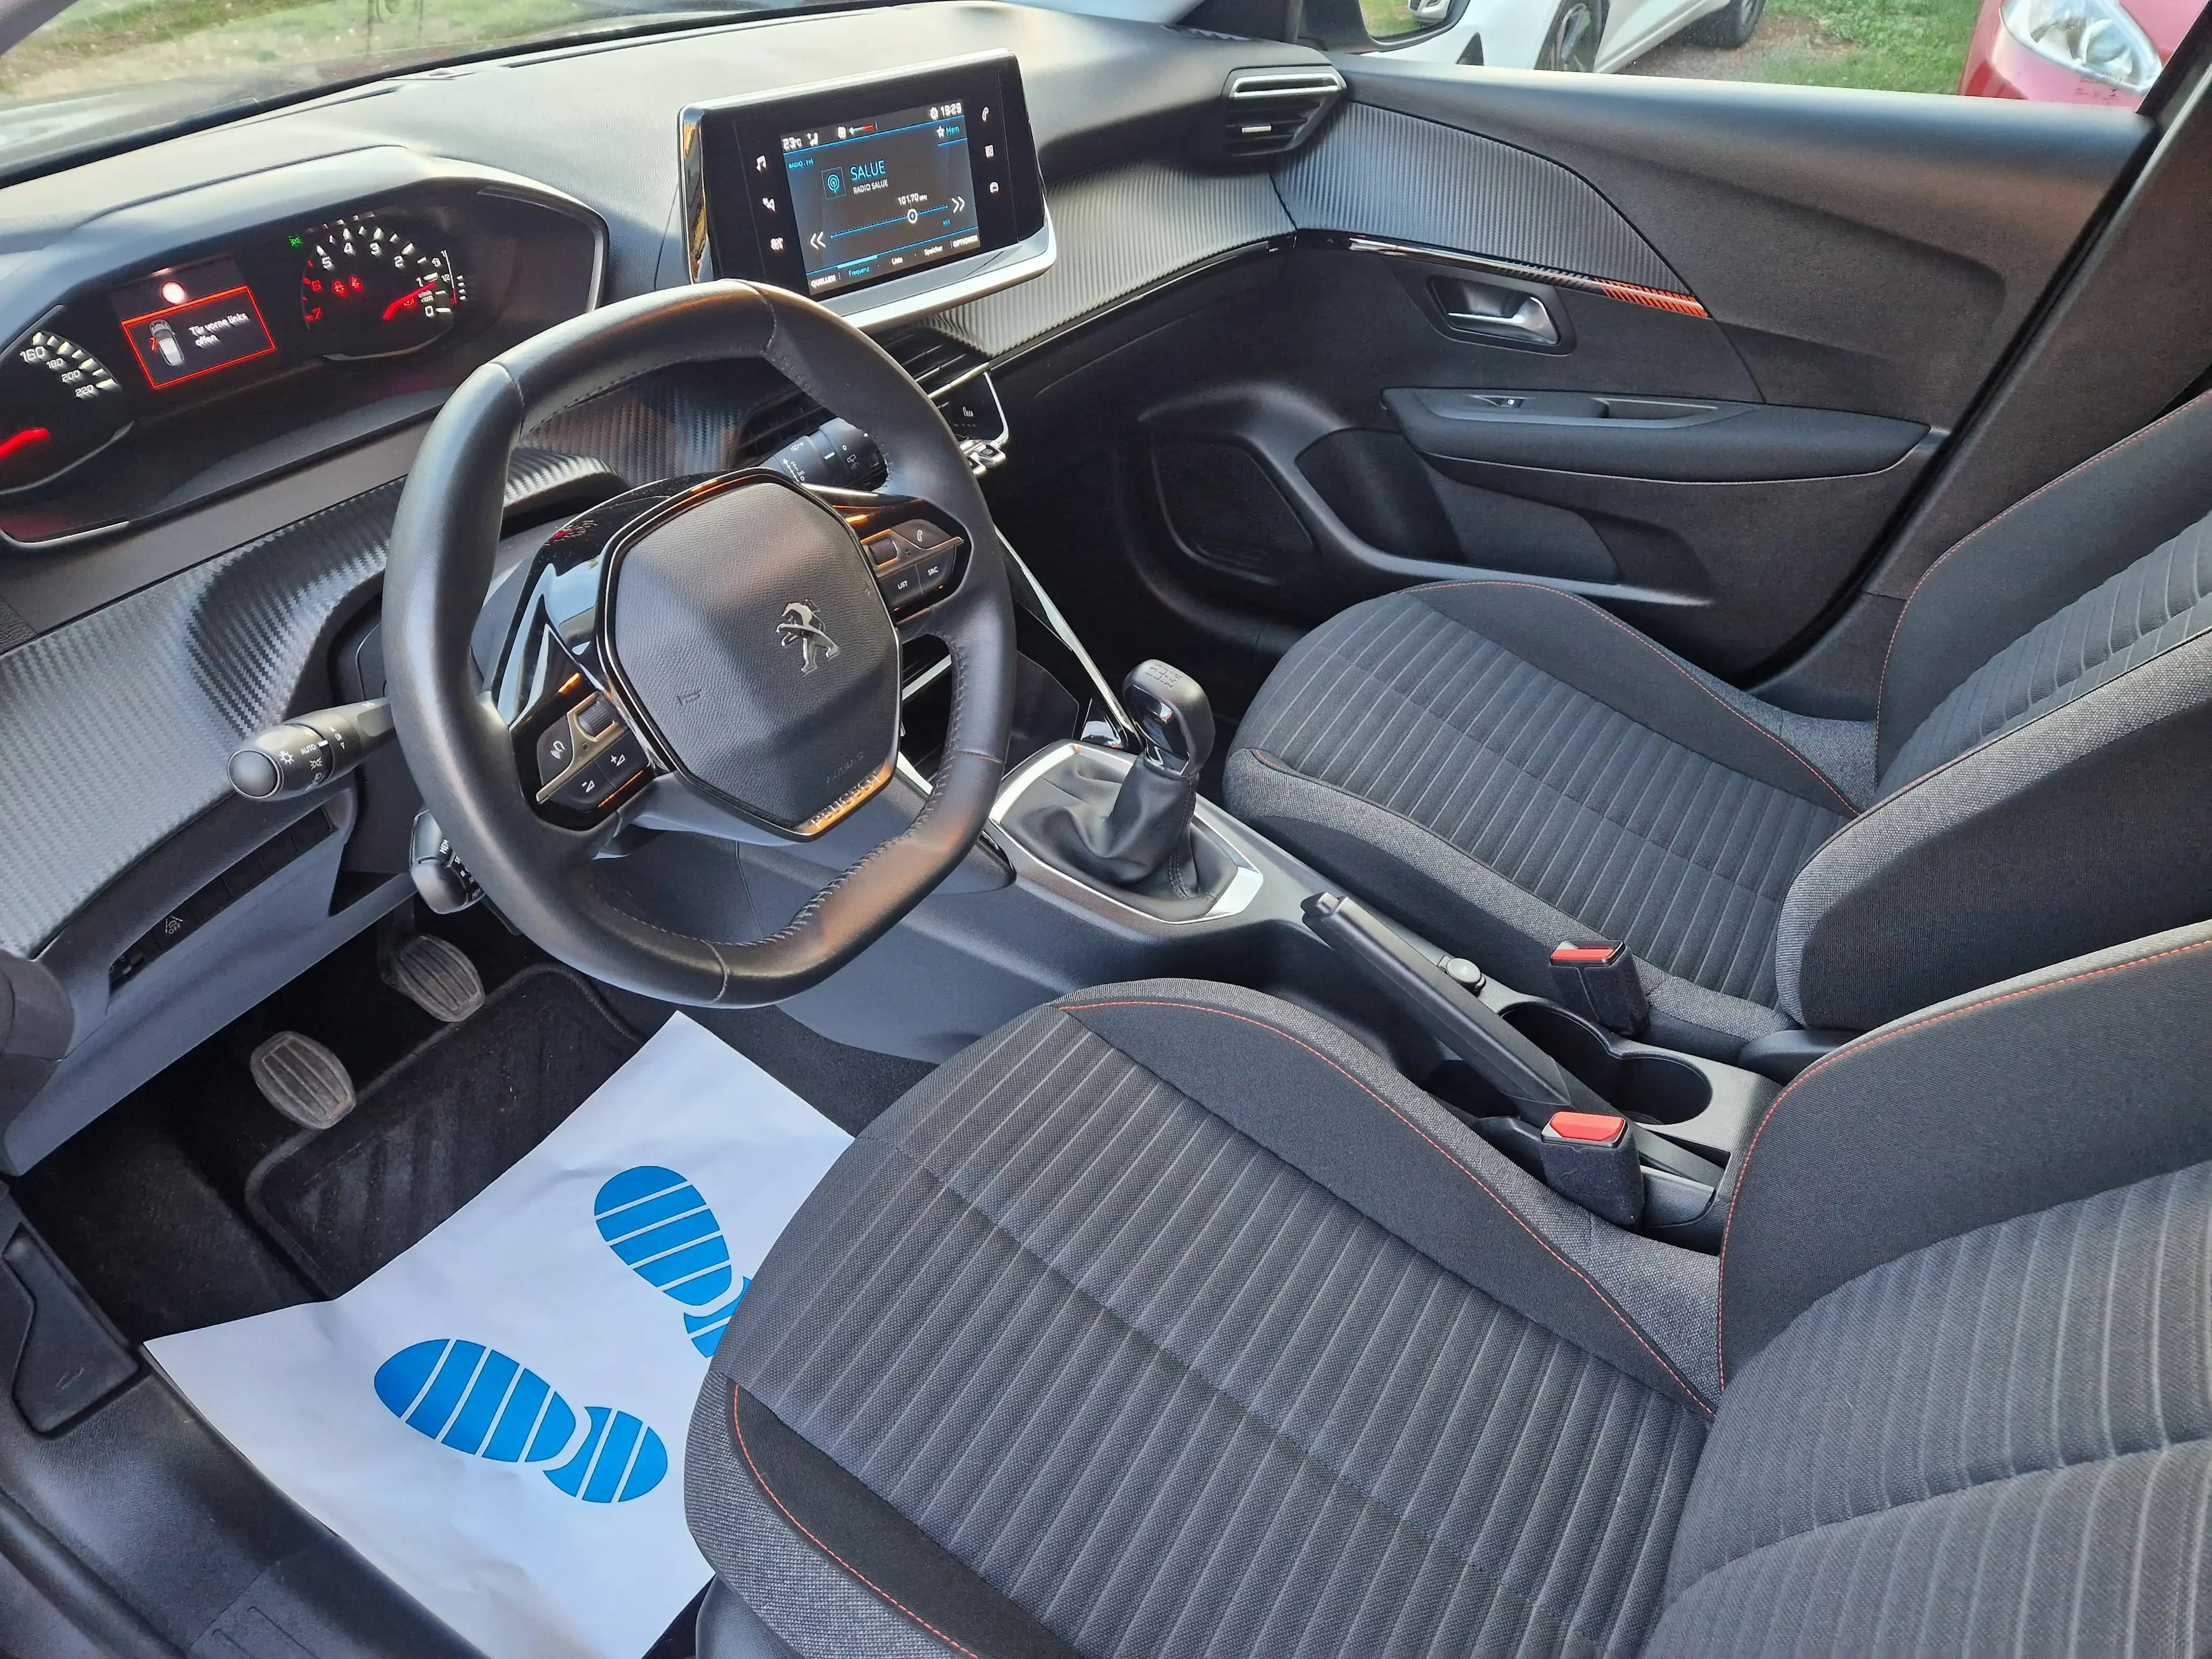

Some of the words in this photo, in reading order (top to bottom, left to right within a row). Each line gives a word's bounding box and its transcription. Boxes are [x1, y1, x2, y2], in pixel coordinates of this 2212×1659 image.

[946, 126, 960, 135] Mem
[850, 160, 887, 182] SALUE
[853, 183, 872, 195] RADIO
[872, 179, 889, 190] SALUE
[343, 242, 355, 255] 4
[369, 242, 382, 256] 3
[321, 256, 335, 271] 5
[393, 255, 405, 269] 2
[848, 266, 870, 277] Frequenz
[810, 274, 837, 288] QUELLEN
[425, 305, 435, 318] 0
[20, 346, 46, 363] 160
[46, 357, 65, 370] 180
[60, 369, 80, 384] 200
[74, 384, 94, 399] 220
[927, 566, 939, 576] SRC
[897, 580, 908, 590] LIST
[300, 744, 316, 755] AUTO
